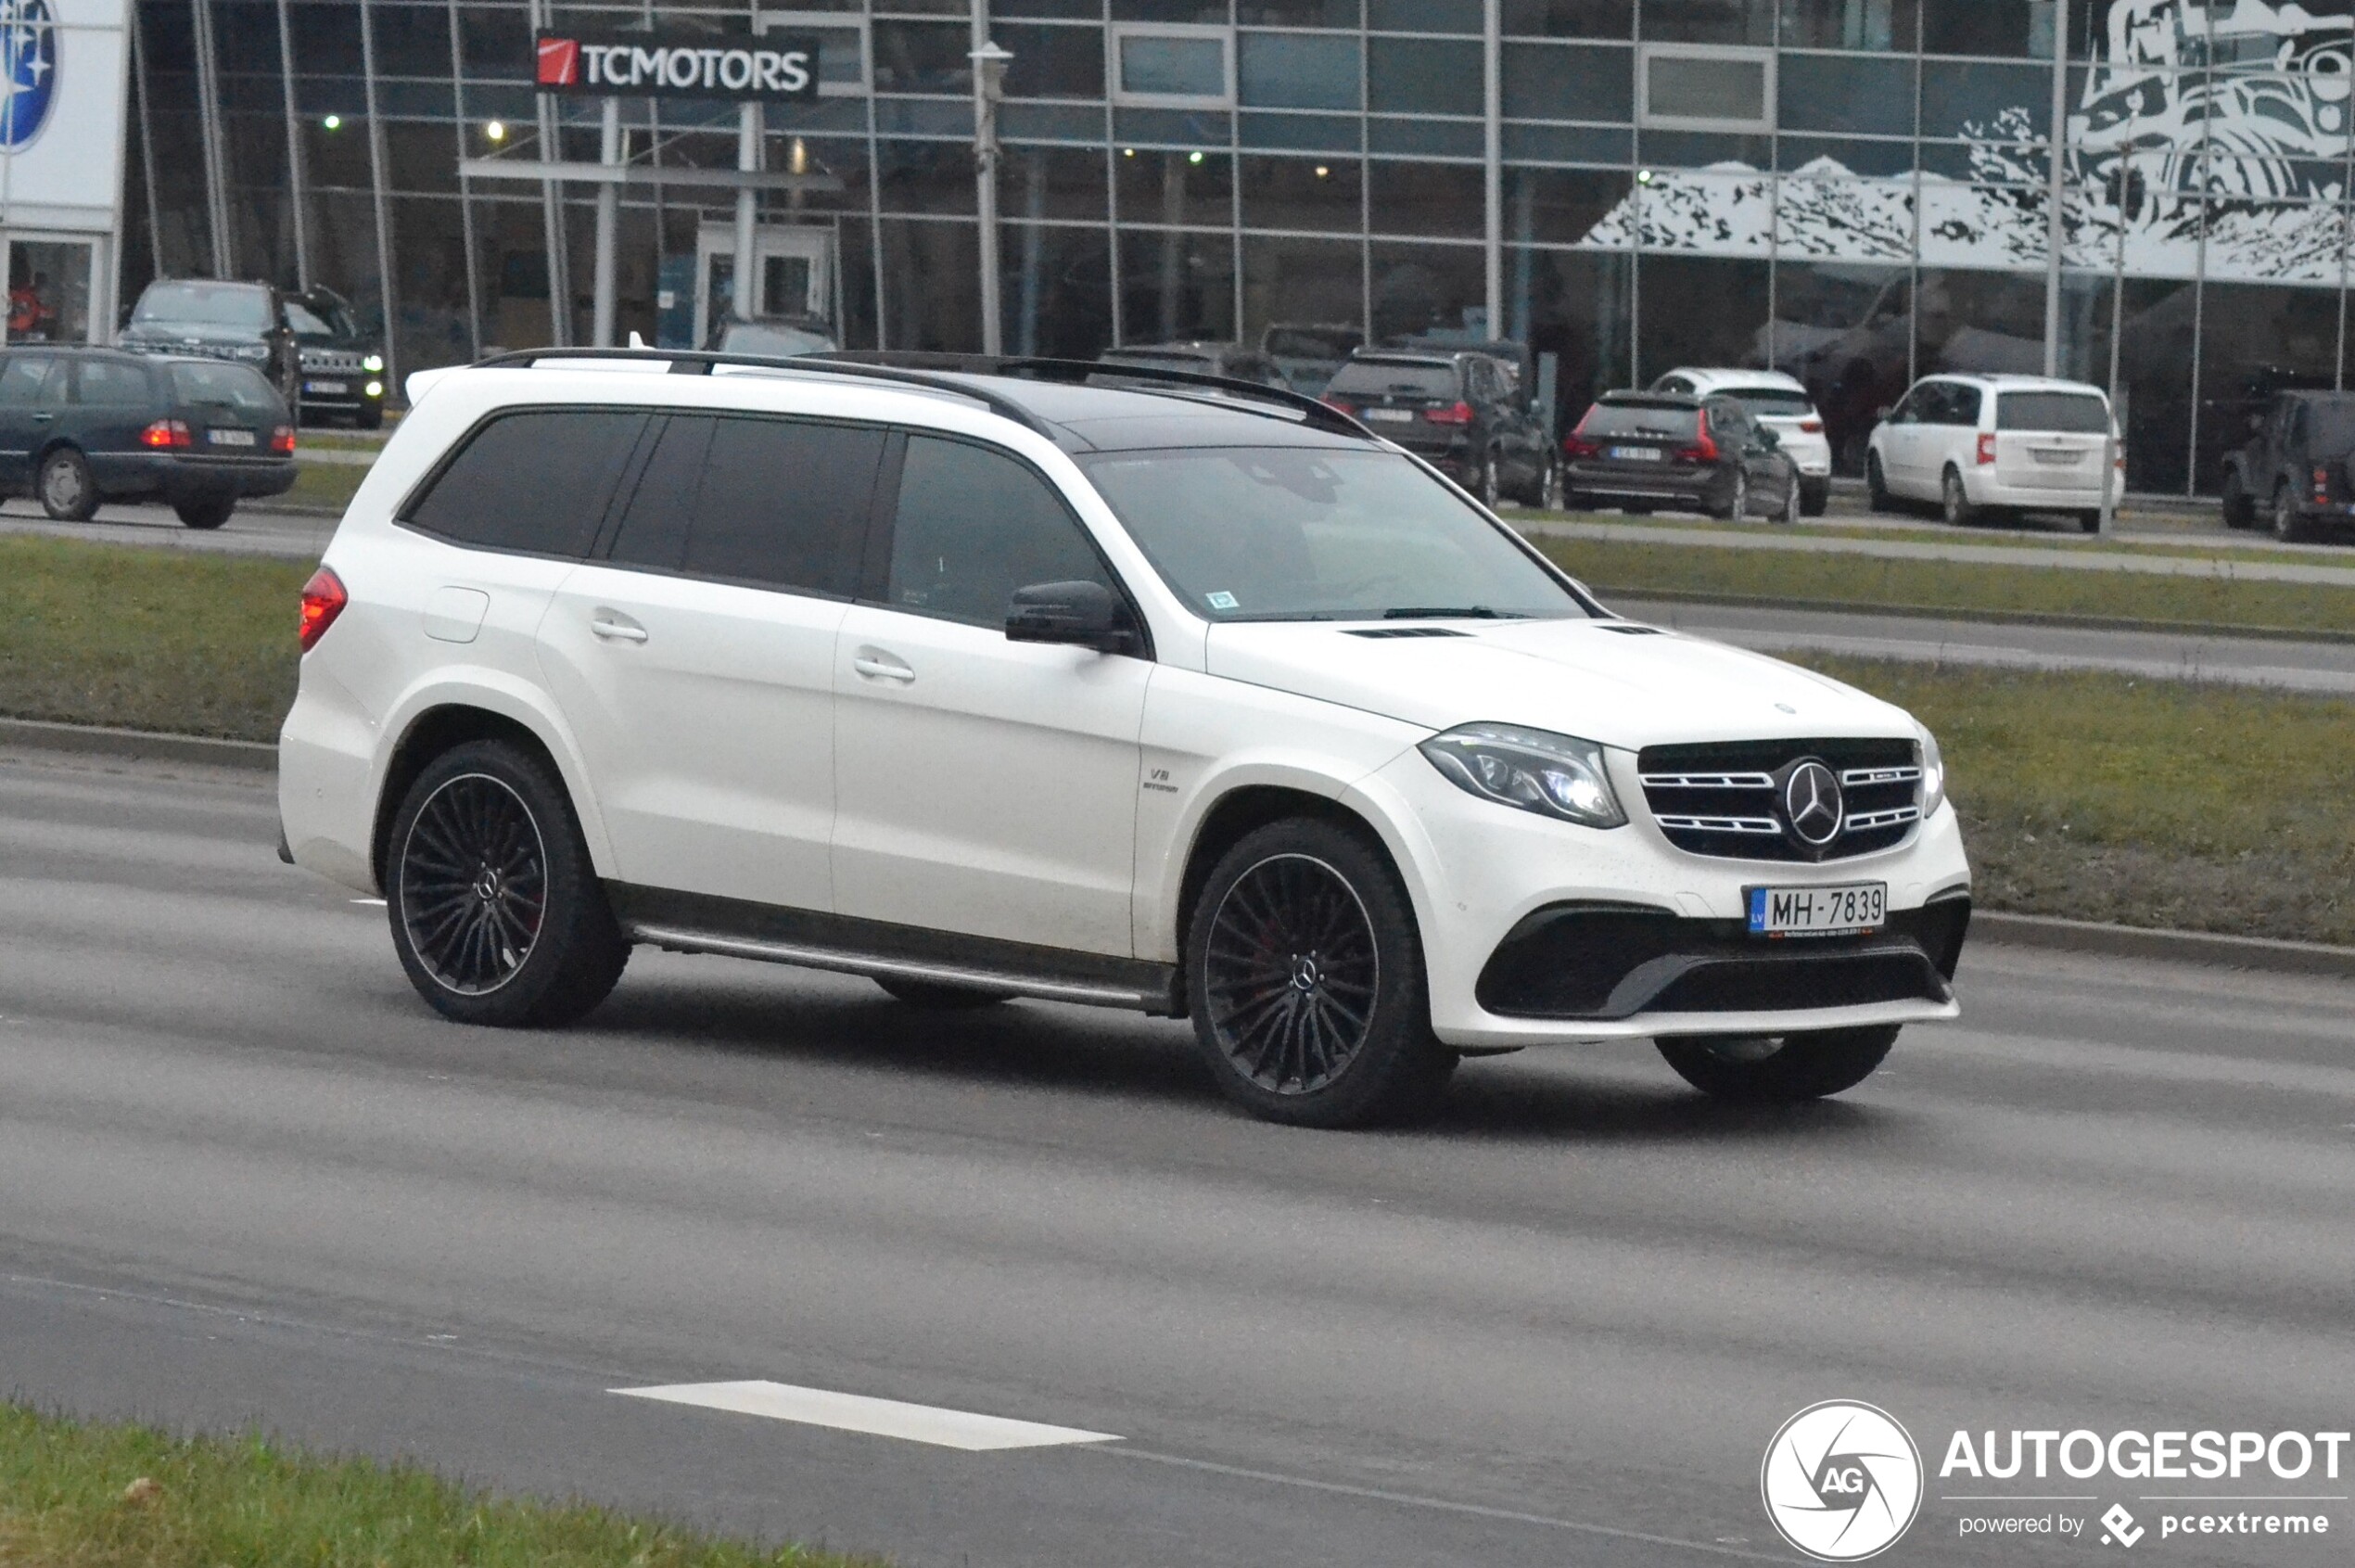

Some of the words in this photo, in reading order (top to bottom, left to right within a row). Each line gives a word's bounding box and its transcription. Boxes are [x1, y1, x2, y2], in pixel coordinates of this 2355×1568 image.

[581, 45, 809, 91] TCMOTORS
[1750, 913, 1763, 924] LV
[1773, 888, 1881, 925] MH-7839
